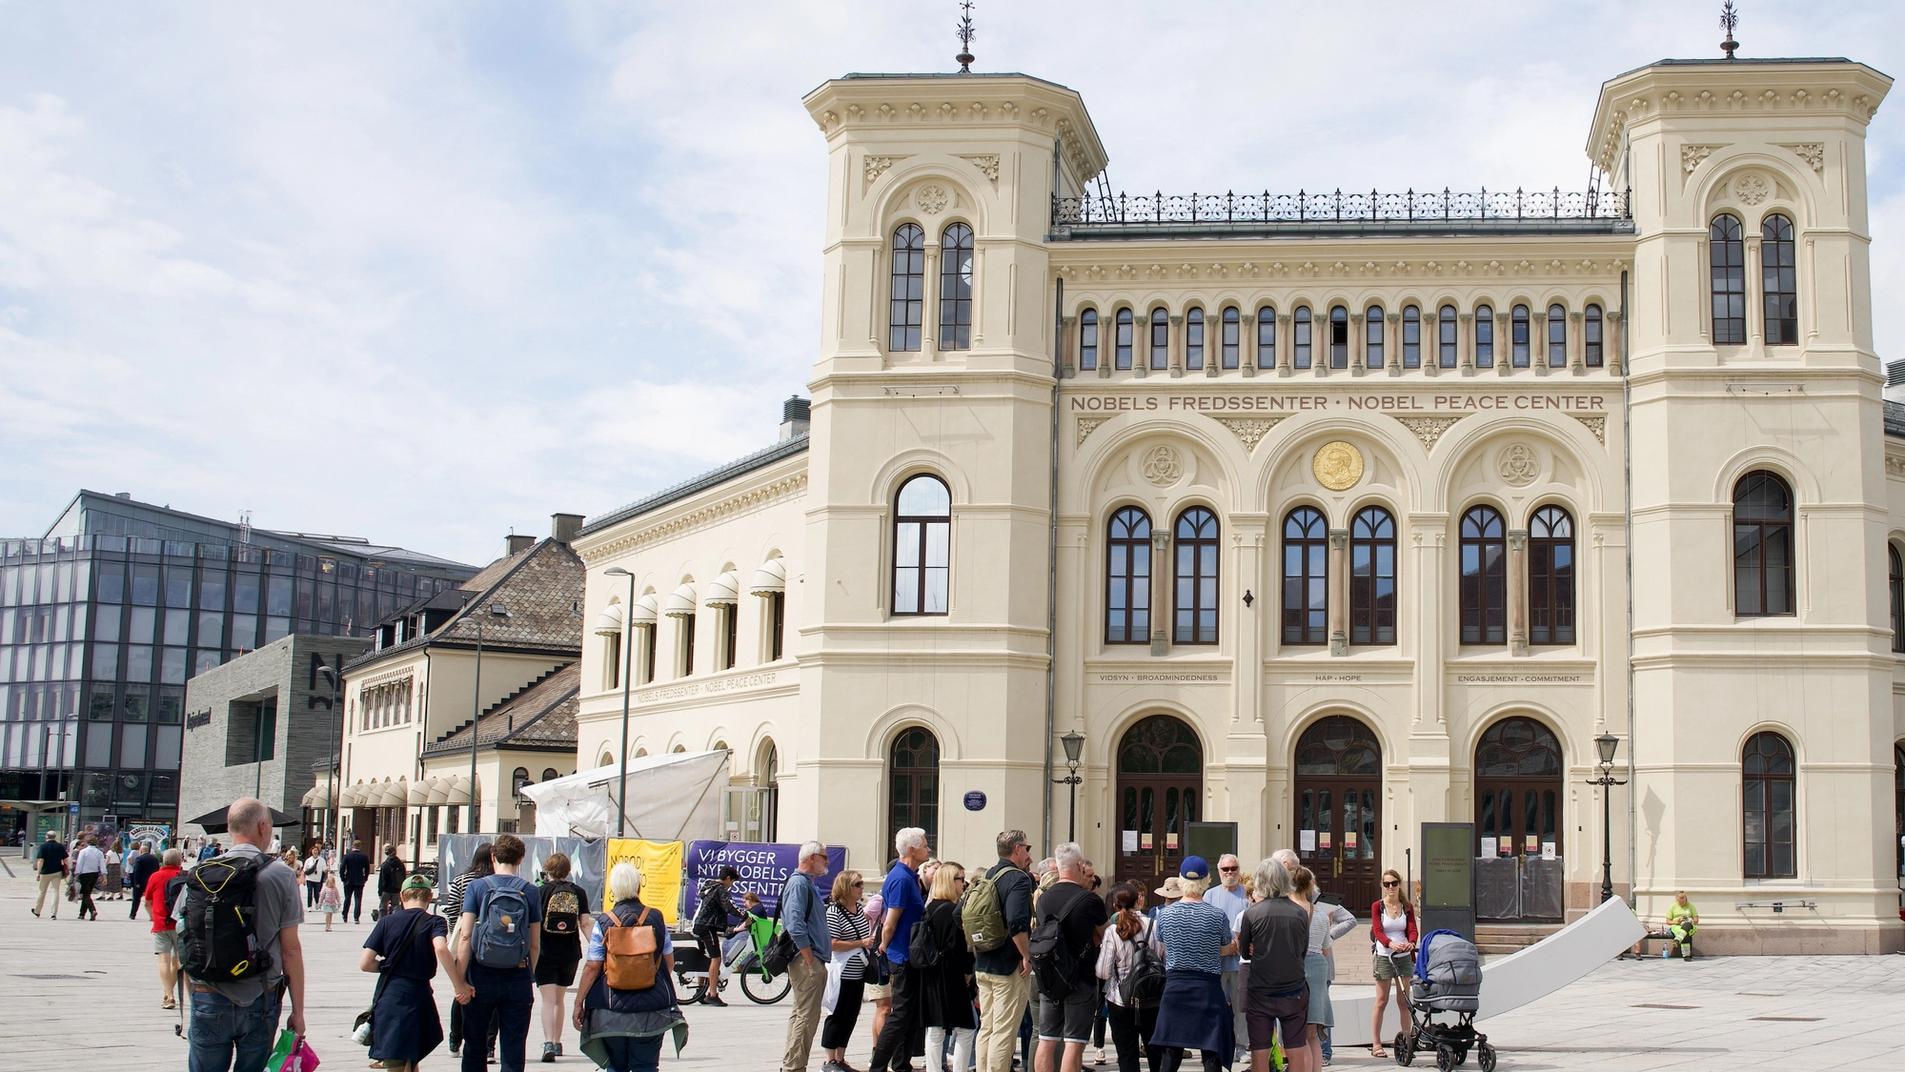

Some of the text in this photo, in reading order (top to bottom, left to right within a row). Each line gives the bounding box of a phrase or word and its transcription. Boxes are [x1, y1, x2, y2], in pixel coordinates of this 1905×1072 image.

[1071, 396, 1604, 411] NOBELS FREDSSENTER NOBEL PEACE CENTER
[704, 681, 725, 693] NOBEL
[727, 677, 748, 690] PEACE
[749, 672, 776, 687] CENTER
[1099, 674, 1218, 682] VIDSYN BROADMINDEDNESS
[1315, 674, 1361, 682] HAP HOPE
[1458, 675, 1581, 683] ENGASJEMENT COMMITMENT
[699, 848, 776, 865] VI BYGGER
